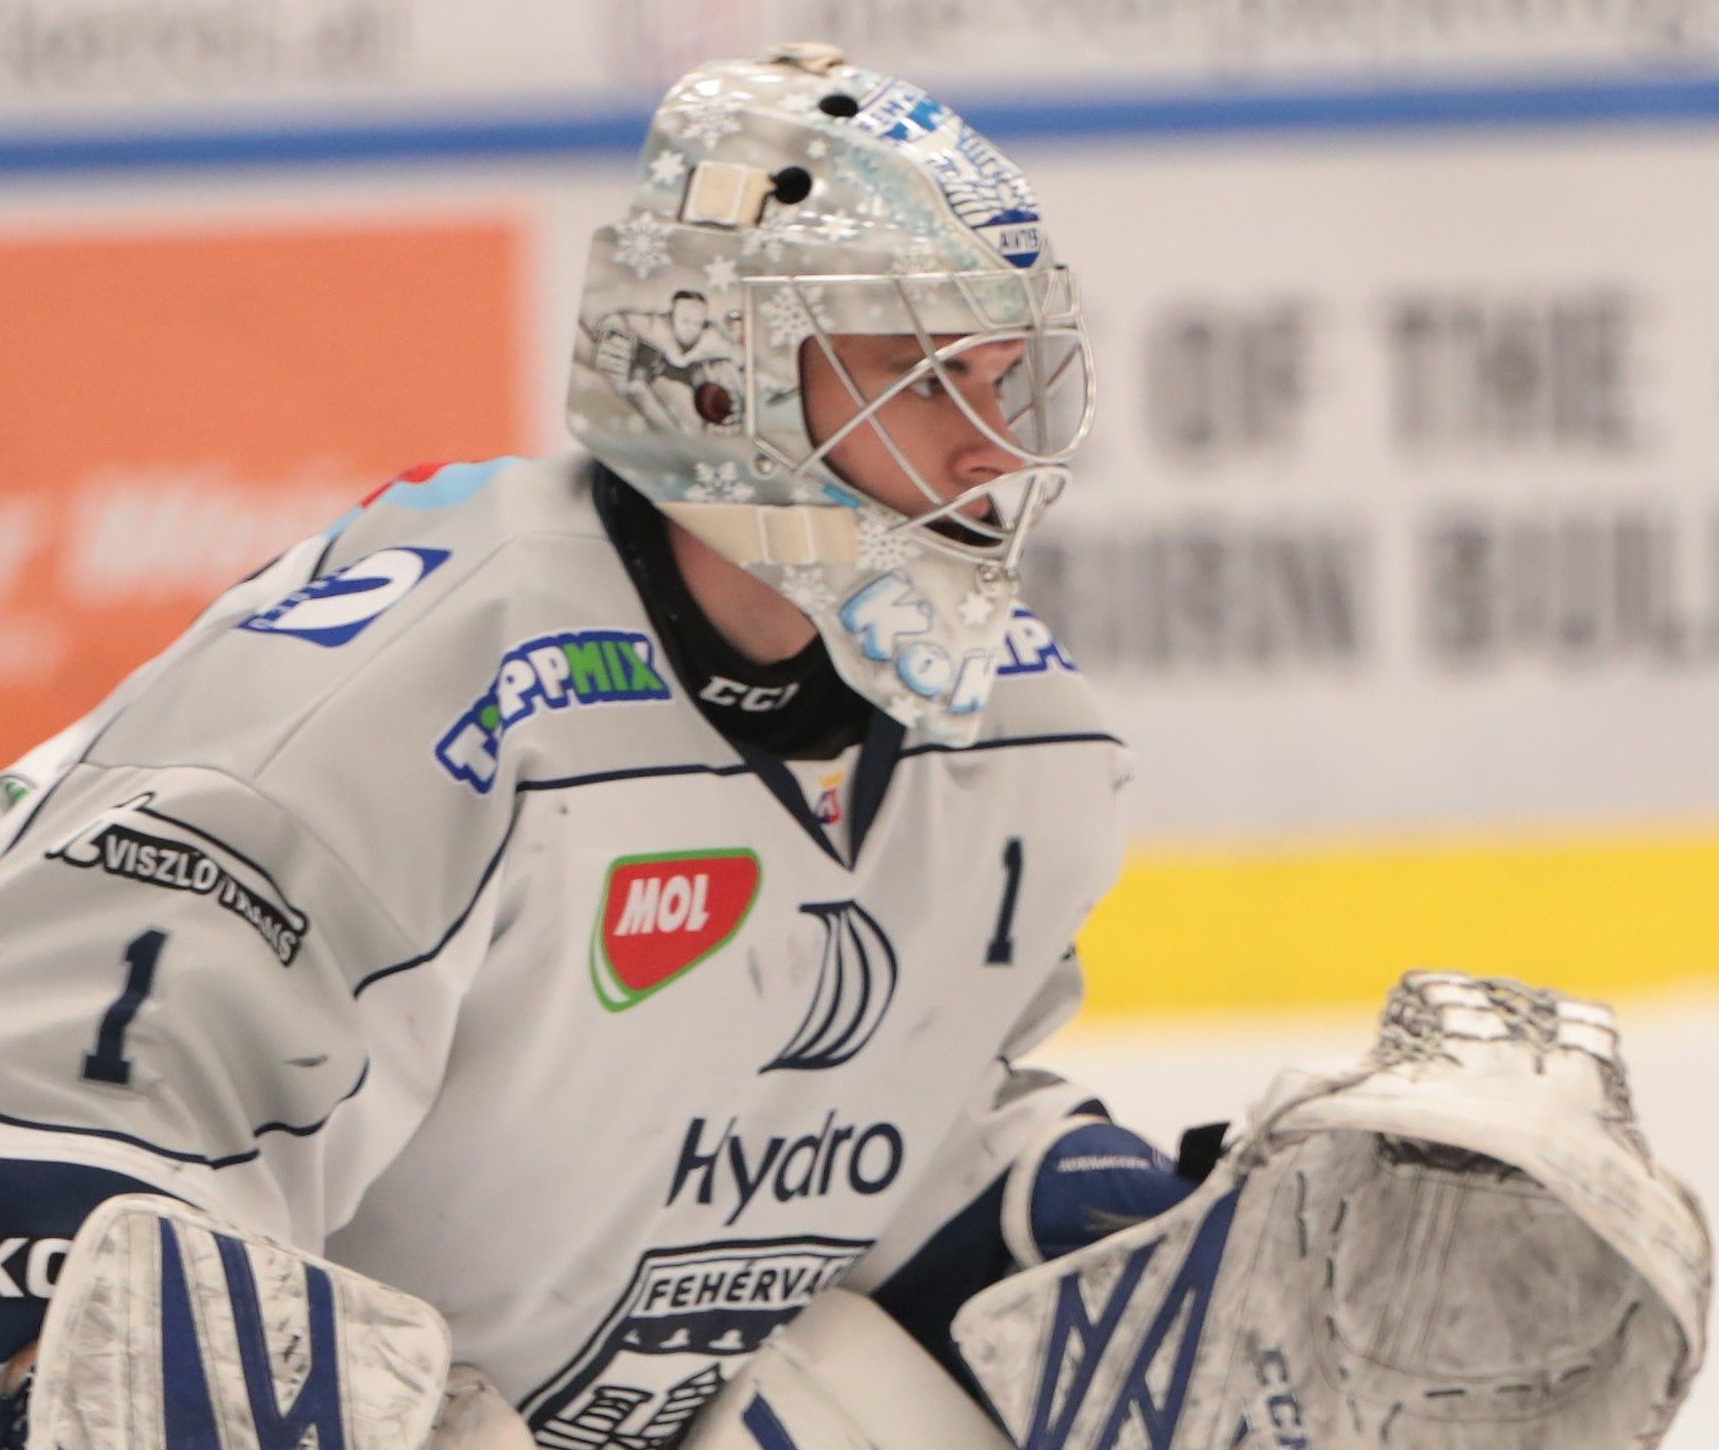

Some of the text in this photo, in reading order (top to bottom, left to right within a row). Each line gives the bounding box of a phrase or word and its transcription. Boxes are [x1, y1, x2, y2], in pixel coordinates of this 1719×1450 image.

[614, 874, 710, 936] MOL
[984, 837, 1023, 965] 1
[83, 928, 169, 1085] 1
[665, 1111, 903, 1227] Hydro
